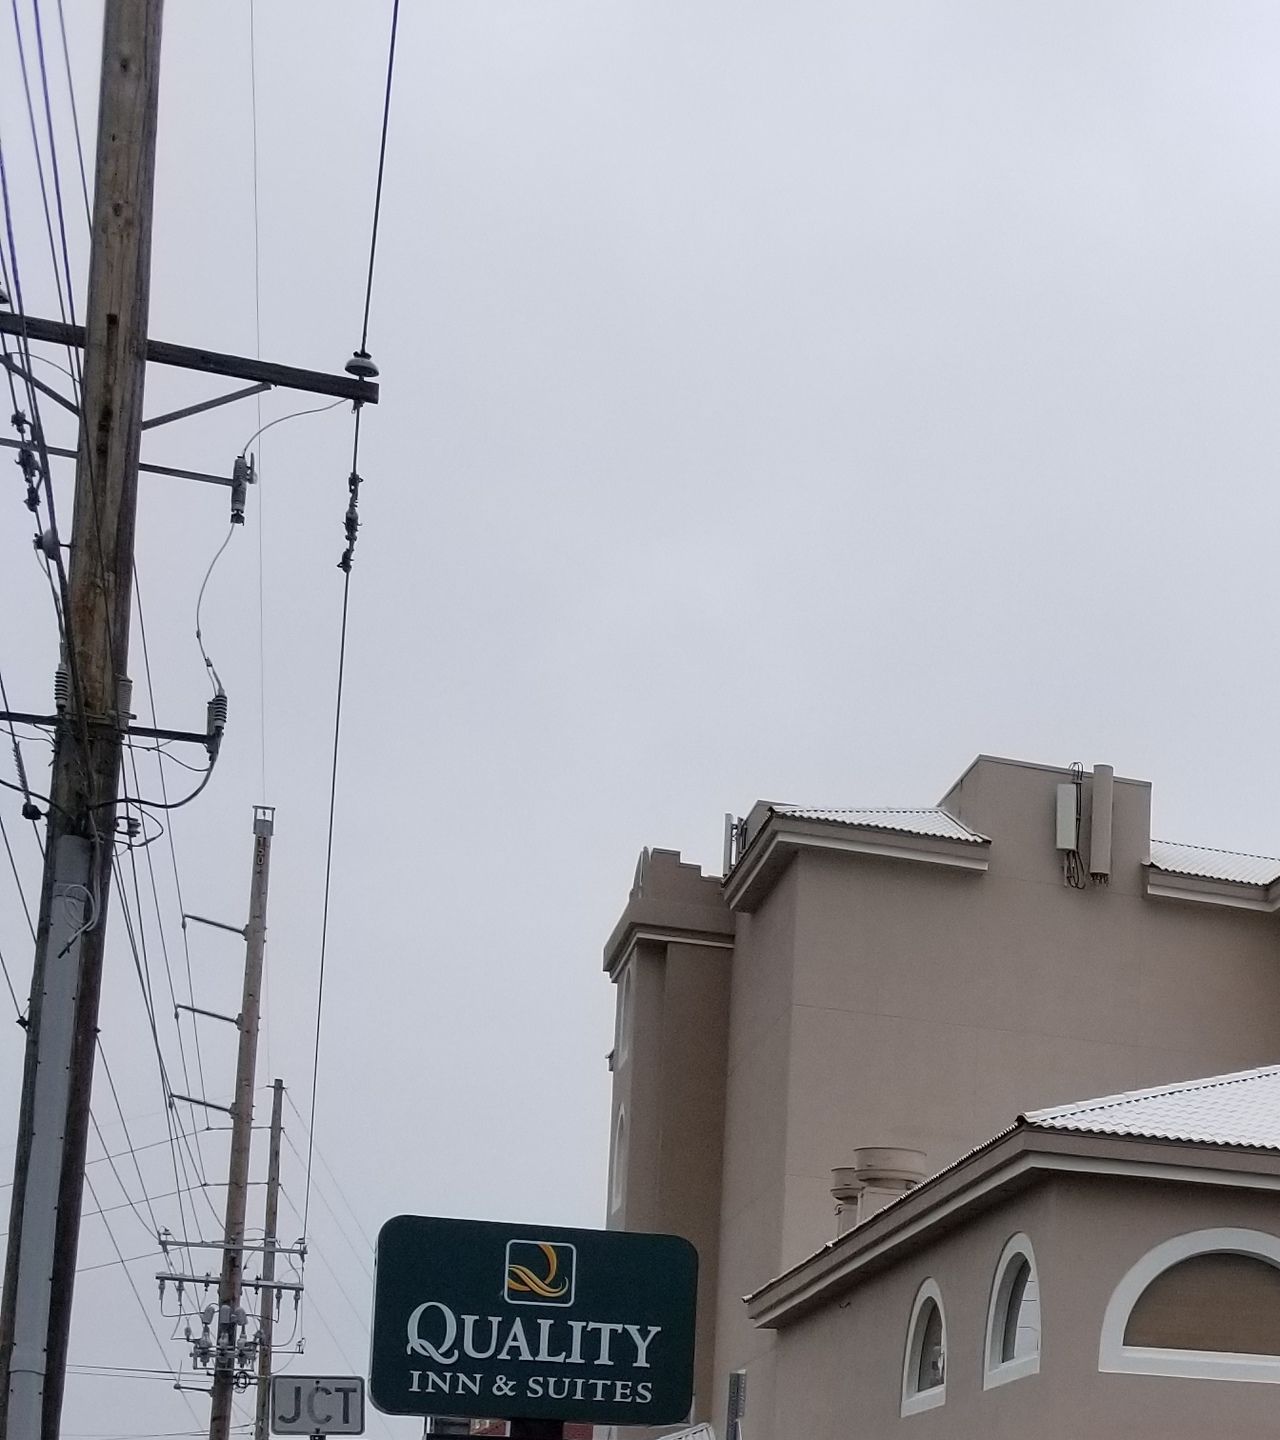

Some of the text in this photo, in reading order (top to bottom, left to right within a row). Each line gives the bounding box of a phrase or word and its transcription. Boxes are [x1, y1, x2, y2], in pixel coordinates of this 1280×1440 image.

[406, 1301, 662, 1368] QUALITY
[278, 1386, 358, 1425] JCT
[408, 1370, 653, 1404] INN & SUITES
